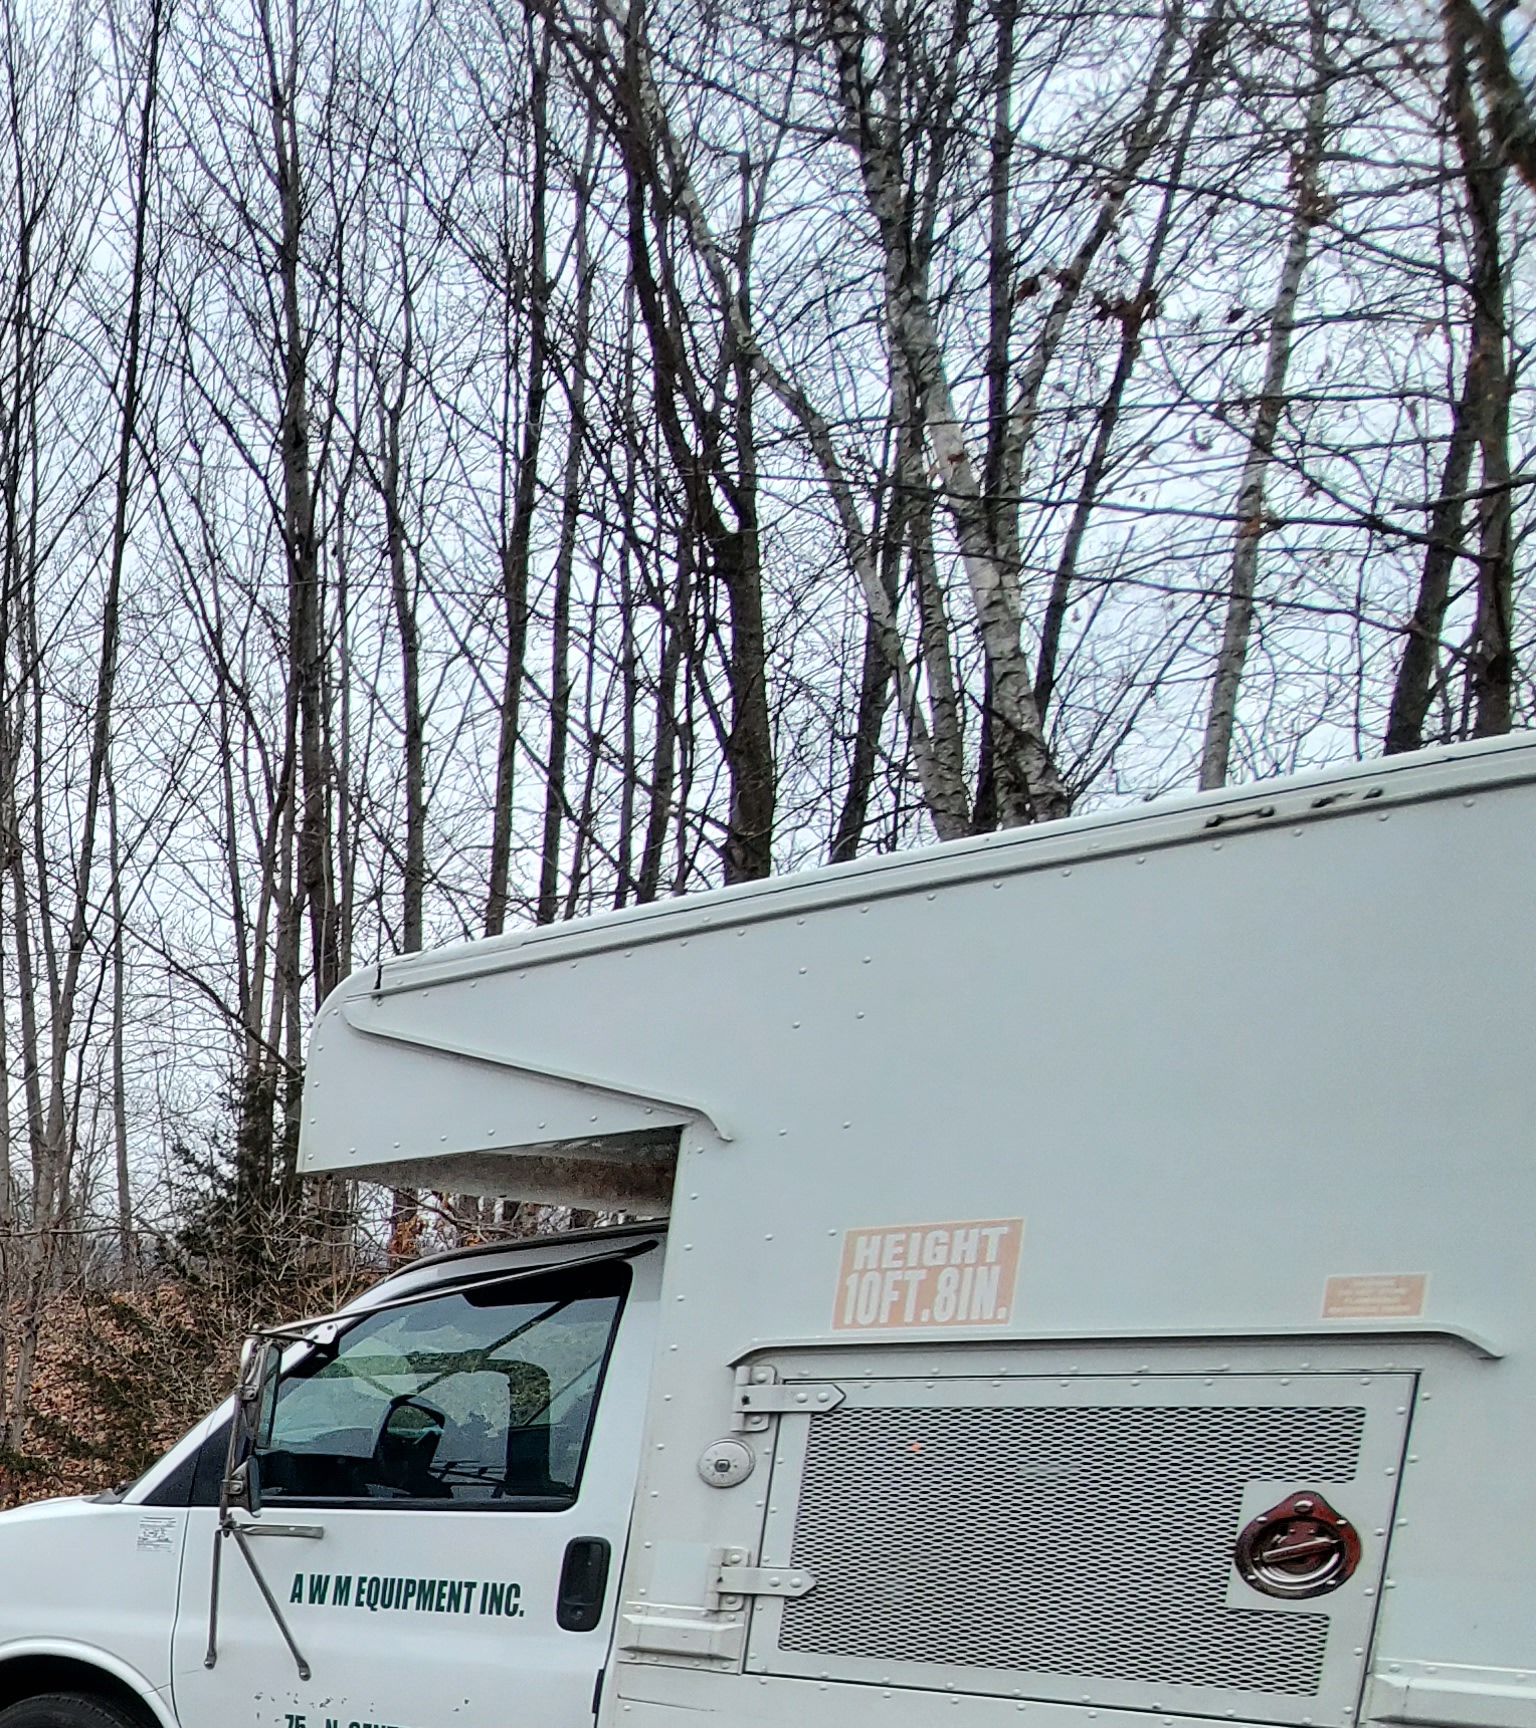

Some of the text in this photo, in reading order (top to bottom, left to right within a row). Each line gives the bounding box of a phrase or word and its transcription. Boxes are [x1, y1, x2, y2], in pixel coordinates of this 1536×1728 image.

[853, 1226, 1009, 1271] HEIGHT
[290, 1574, 525, 1618] A W M EQUIPMENT INC.
